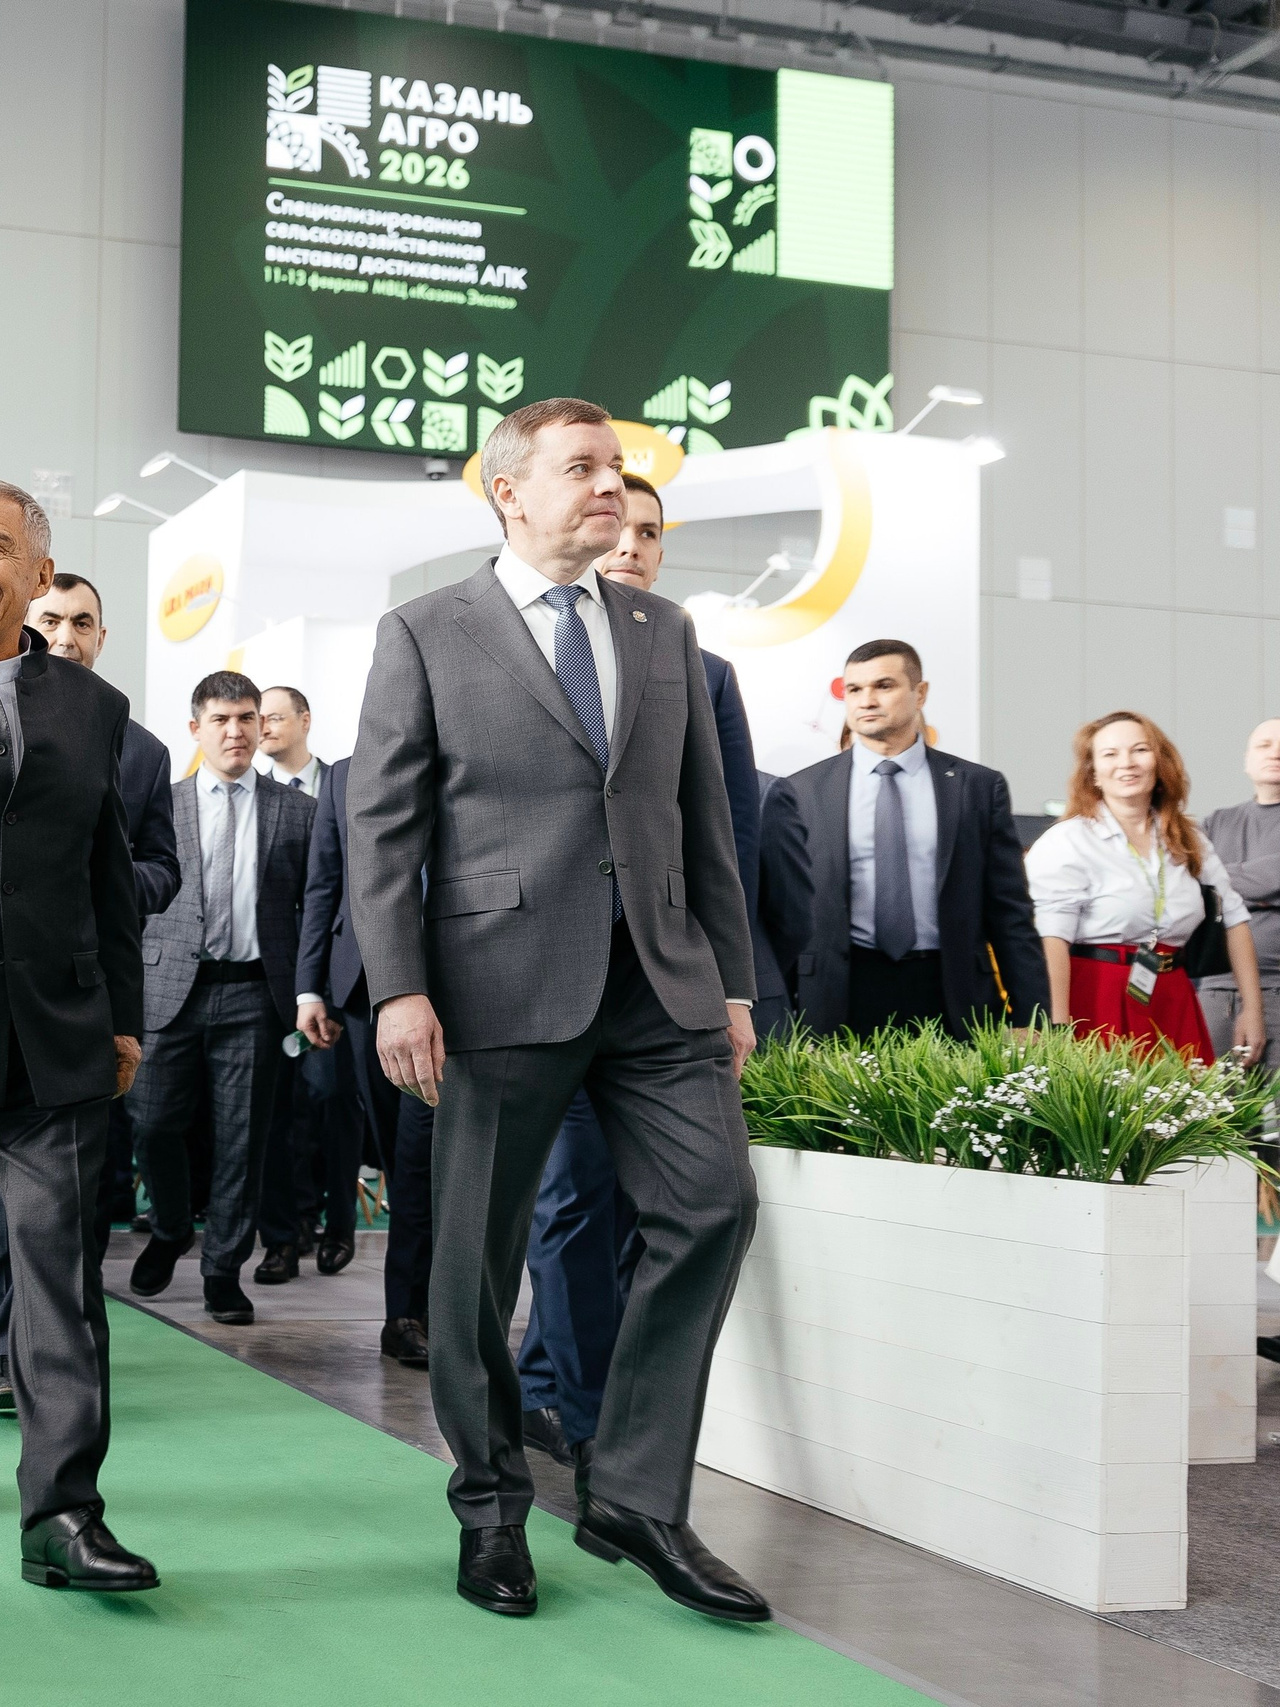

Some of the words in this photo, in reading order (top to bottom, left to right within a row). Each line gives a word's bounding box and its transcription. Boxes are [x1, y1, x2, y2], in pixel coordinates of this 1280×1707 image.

[379, 74, 534, 125] КАЗАНЬ
[378, 112, 479, 154] АГРО
[379, 148, 470, 190] 2026
[265, 190, 483, 240] Специализированная
[265, 220, 486, 262] сельскохозяйственная
[263, 265, 308, 287] 11-13
[264, 244, 359, 271] выставка
[359, 254, 479, 285] достижений
[479, 263, 528, 291] АПК
